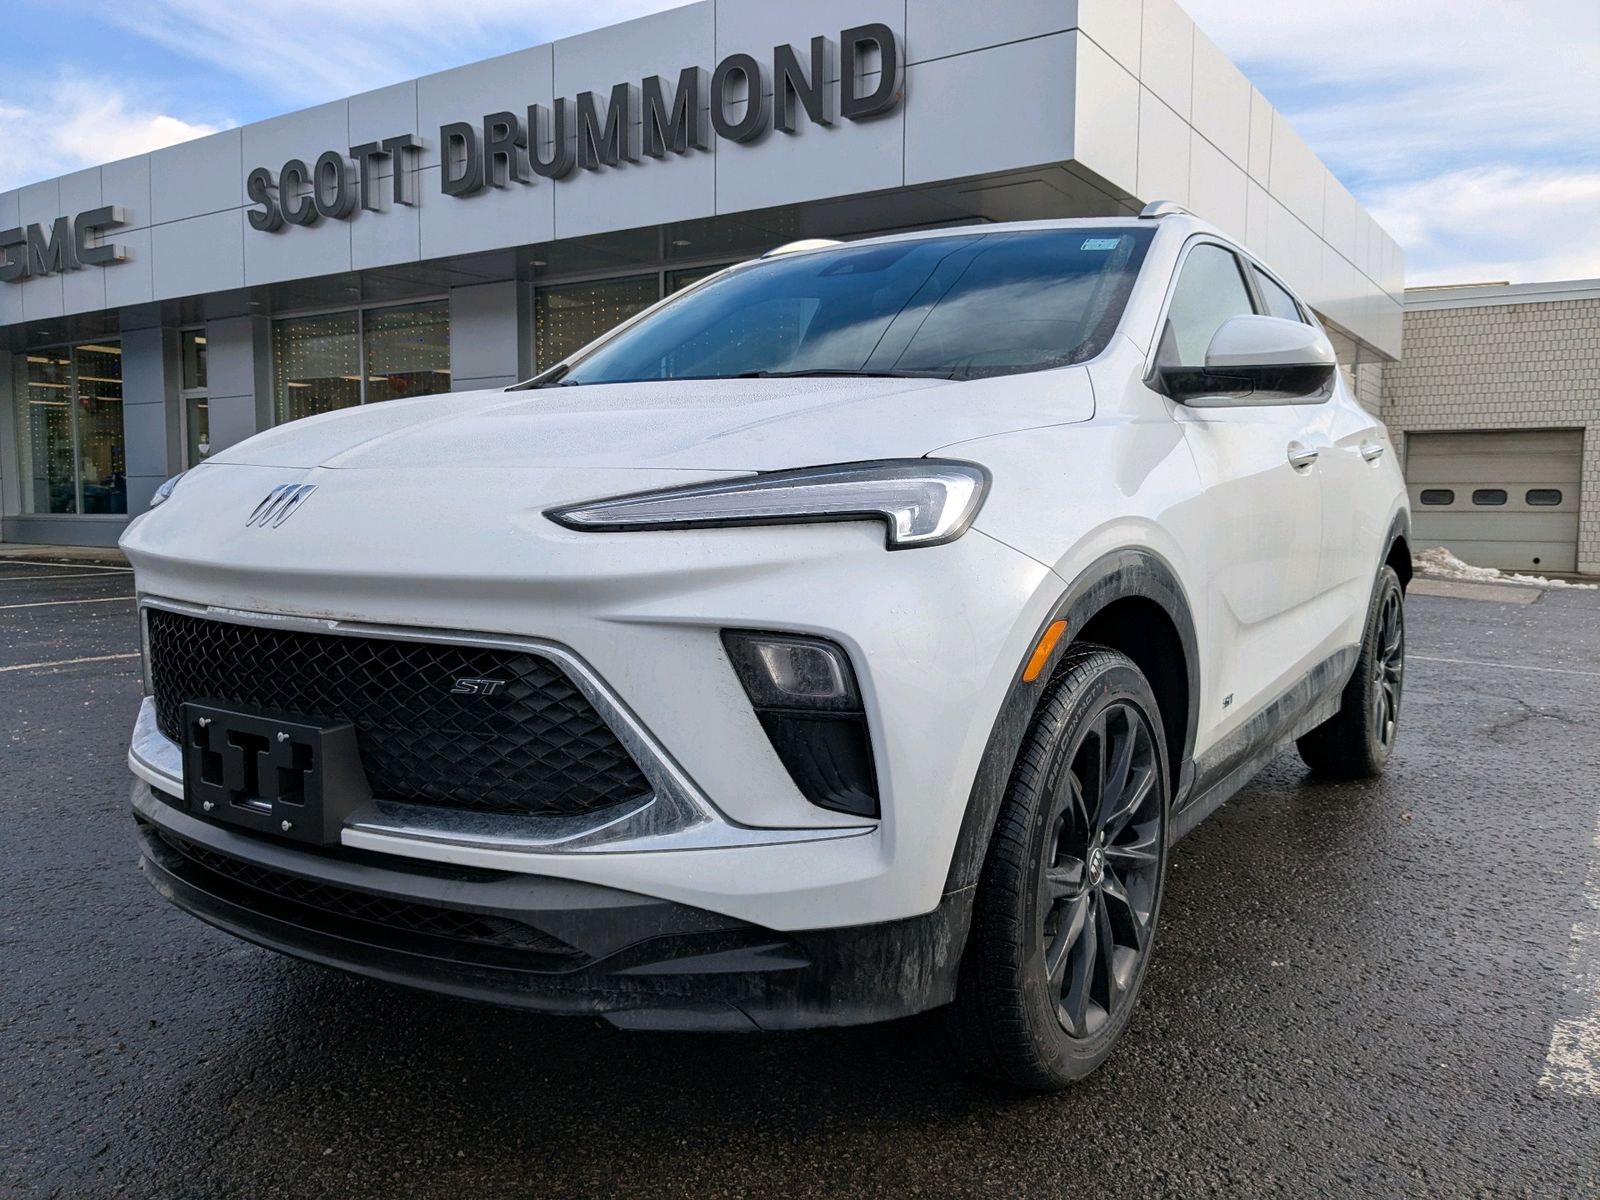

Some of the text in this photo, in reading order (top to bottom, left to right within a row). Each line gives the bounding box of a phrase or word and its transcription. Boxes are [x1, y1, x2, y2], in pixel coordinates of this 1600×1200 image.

[247, 22, 903, 233] SCOTT DRUMMOND
[0, 205, 124, 283] GMC
[450, 678, 506, 695] ST
